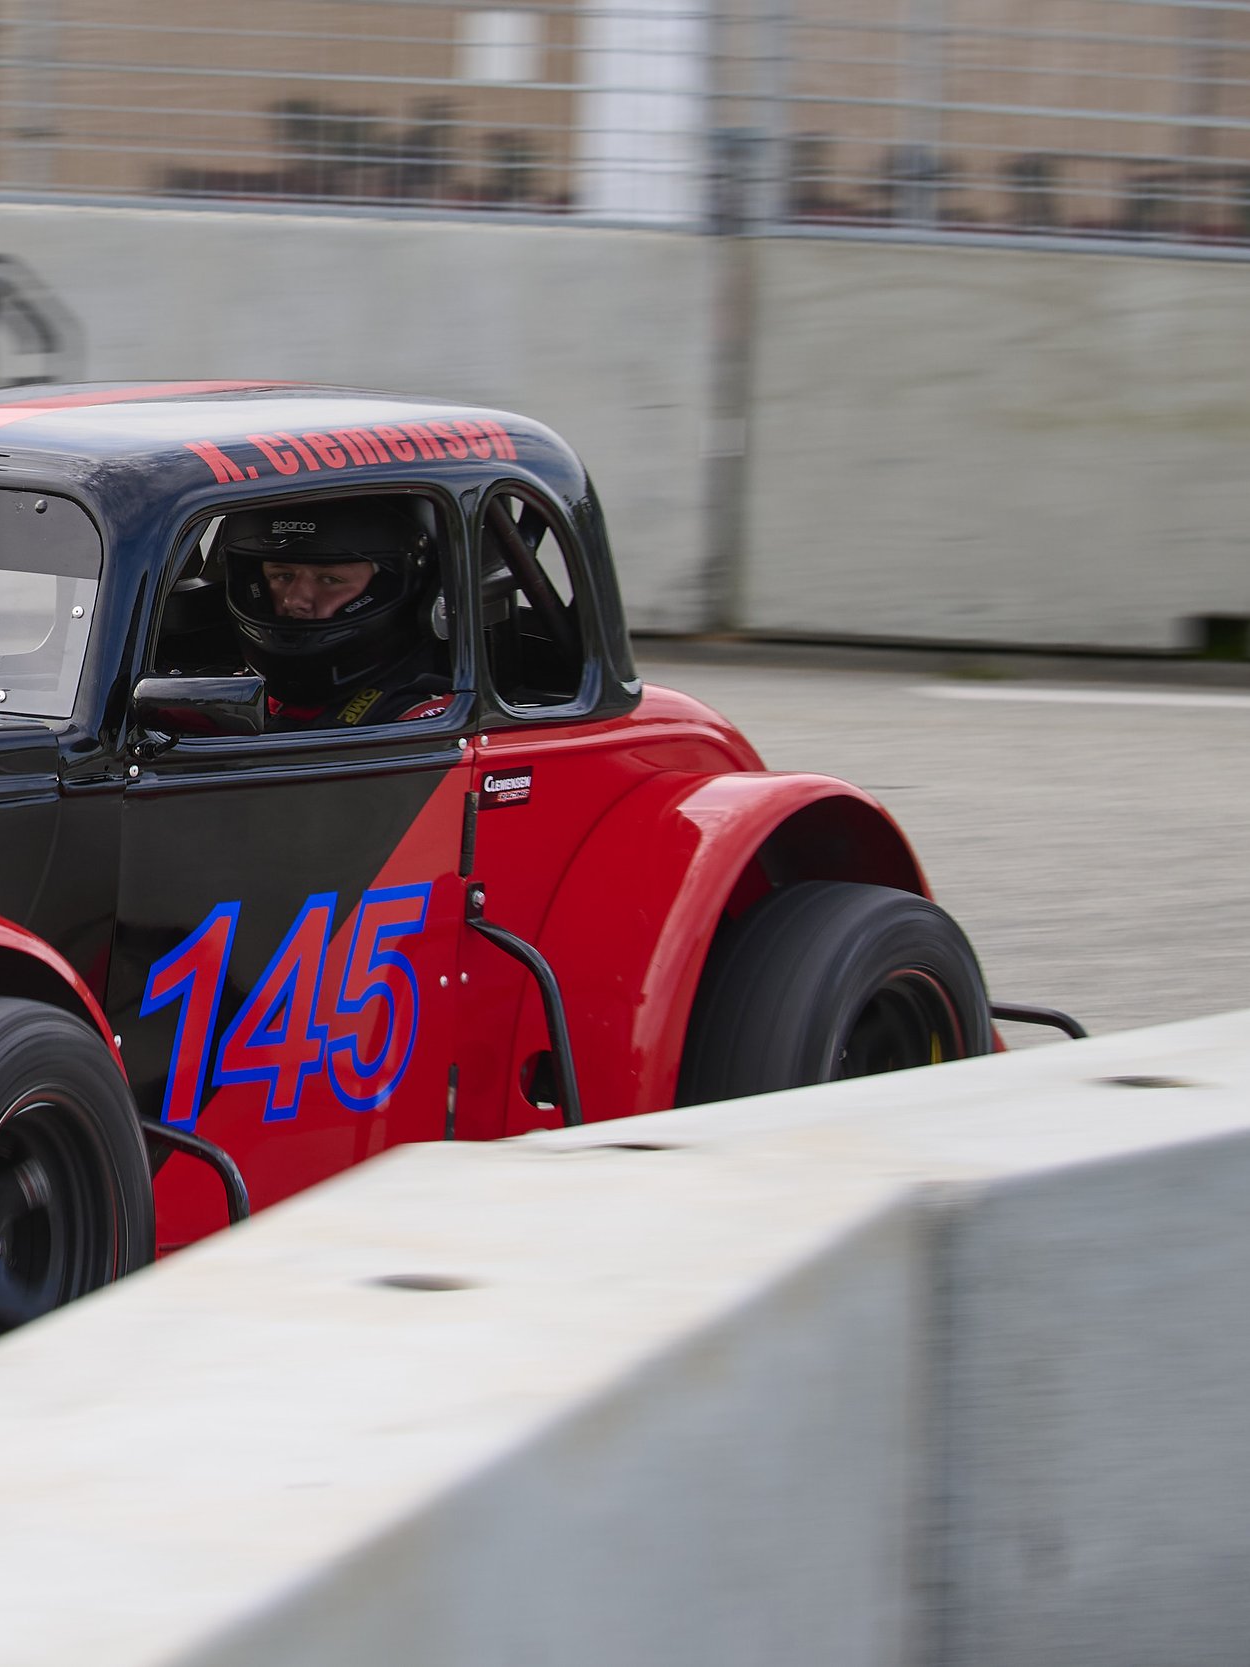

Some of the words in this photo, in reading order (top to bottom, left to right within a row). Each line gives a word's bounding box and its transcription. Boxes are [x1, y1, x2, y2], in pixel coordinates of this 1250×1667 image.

[246, 419, 518, 476] Clemensen
[272, 520, 316, 533] sparco
[139, 881, 433, 1133] 145
